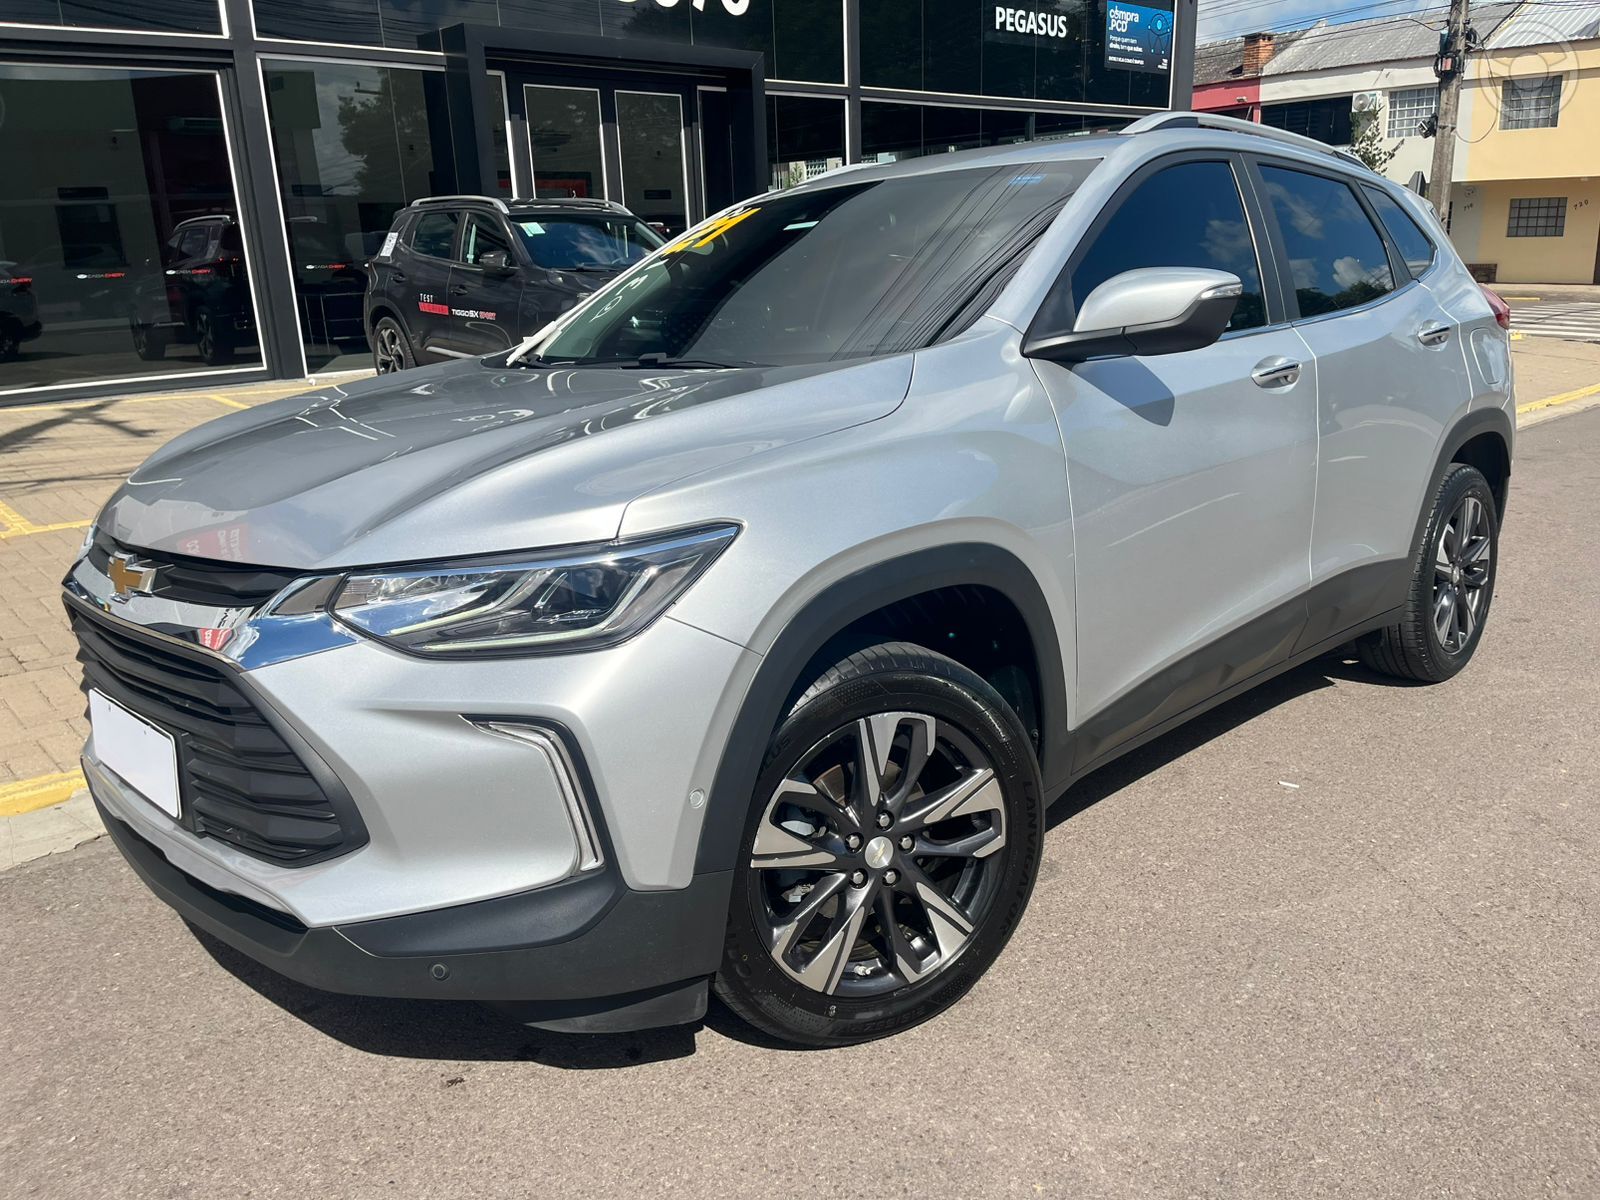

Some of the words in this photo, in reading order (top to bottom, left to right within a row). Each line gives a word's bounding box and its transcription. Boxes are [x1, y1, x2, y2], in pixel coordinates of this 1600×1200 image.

[995, 6, 1067, 38] PEGASUS
[1573, 199, 1589, 210] 720
[419, 293, 433, 303] TEST
